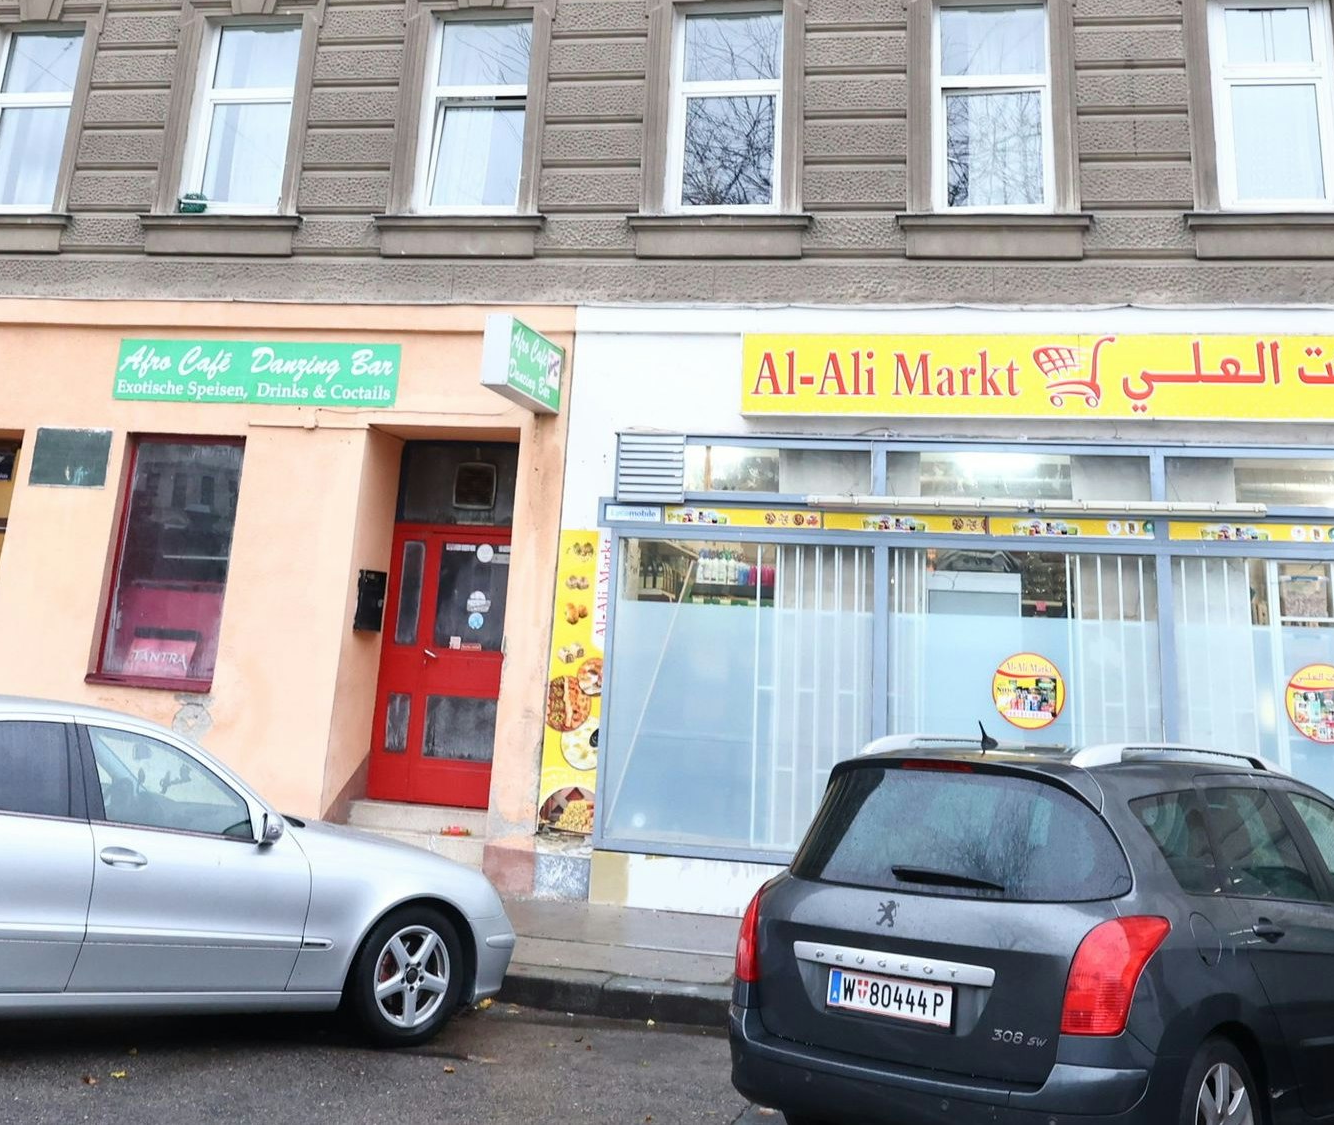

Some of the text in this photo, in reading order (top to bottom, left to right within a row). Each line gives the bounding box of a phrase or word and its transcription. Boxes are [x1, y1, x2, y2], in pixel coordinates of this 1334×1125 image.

[512, 328, 529, 357] Afro
[119, 345, 394, 382] Afro Café Danzing Bar
[751, 350, 1020, 396] Al-Ali Markt
[1123, 341, 1280, 412] العلي
[117, 379, 391, 401] Exotische Speisen, Drinks & Coctails
[595, 539, 611, 636] Al-Ali Markt
[131, 649, 187, 671] TANTRA
[843, 977, 856, 1002] W
[992, 1028, 1023, 1045] 308
